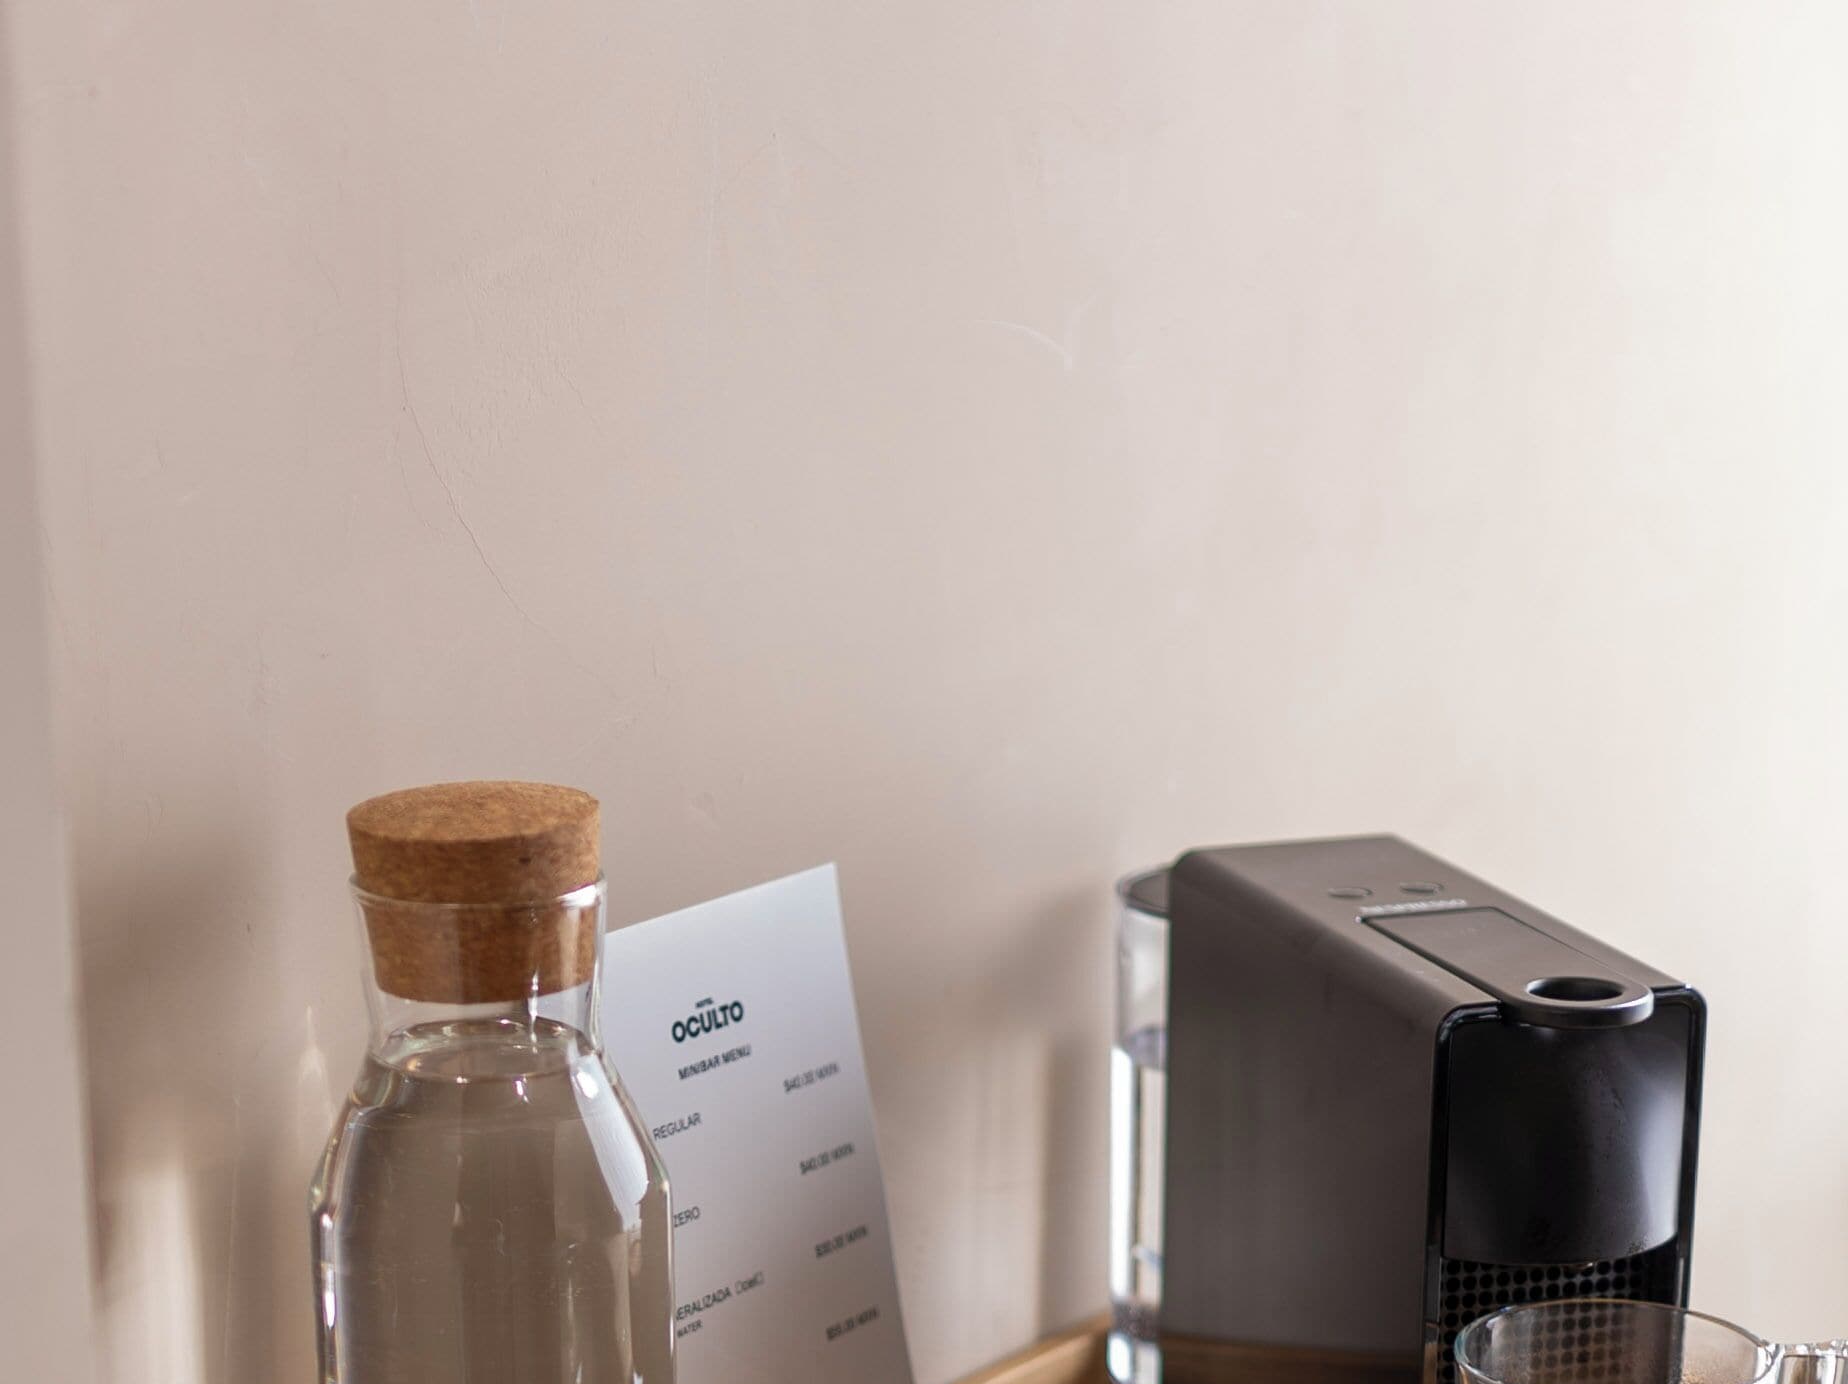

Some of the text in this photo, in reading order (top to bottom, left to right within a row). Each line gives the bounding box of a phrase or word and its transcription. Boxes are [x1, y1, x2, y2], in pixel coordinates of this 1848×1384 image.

[671, 1000, 744, 1043] OCULTO
[678, 1044, 752, 1080] MINIBAR MENU
[653, 1112, 702, 1140] REGULAR
[673, 1206, 701, 1228] ZERO
[675, 1287, 732, 1321] ERALIZADA
